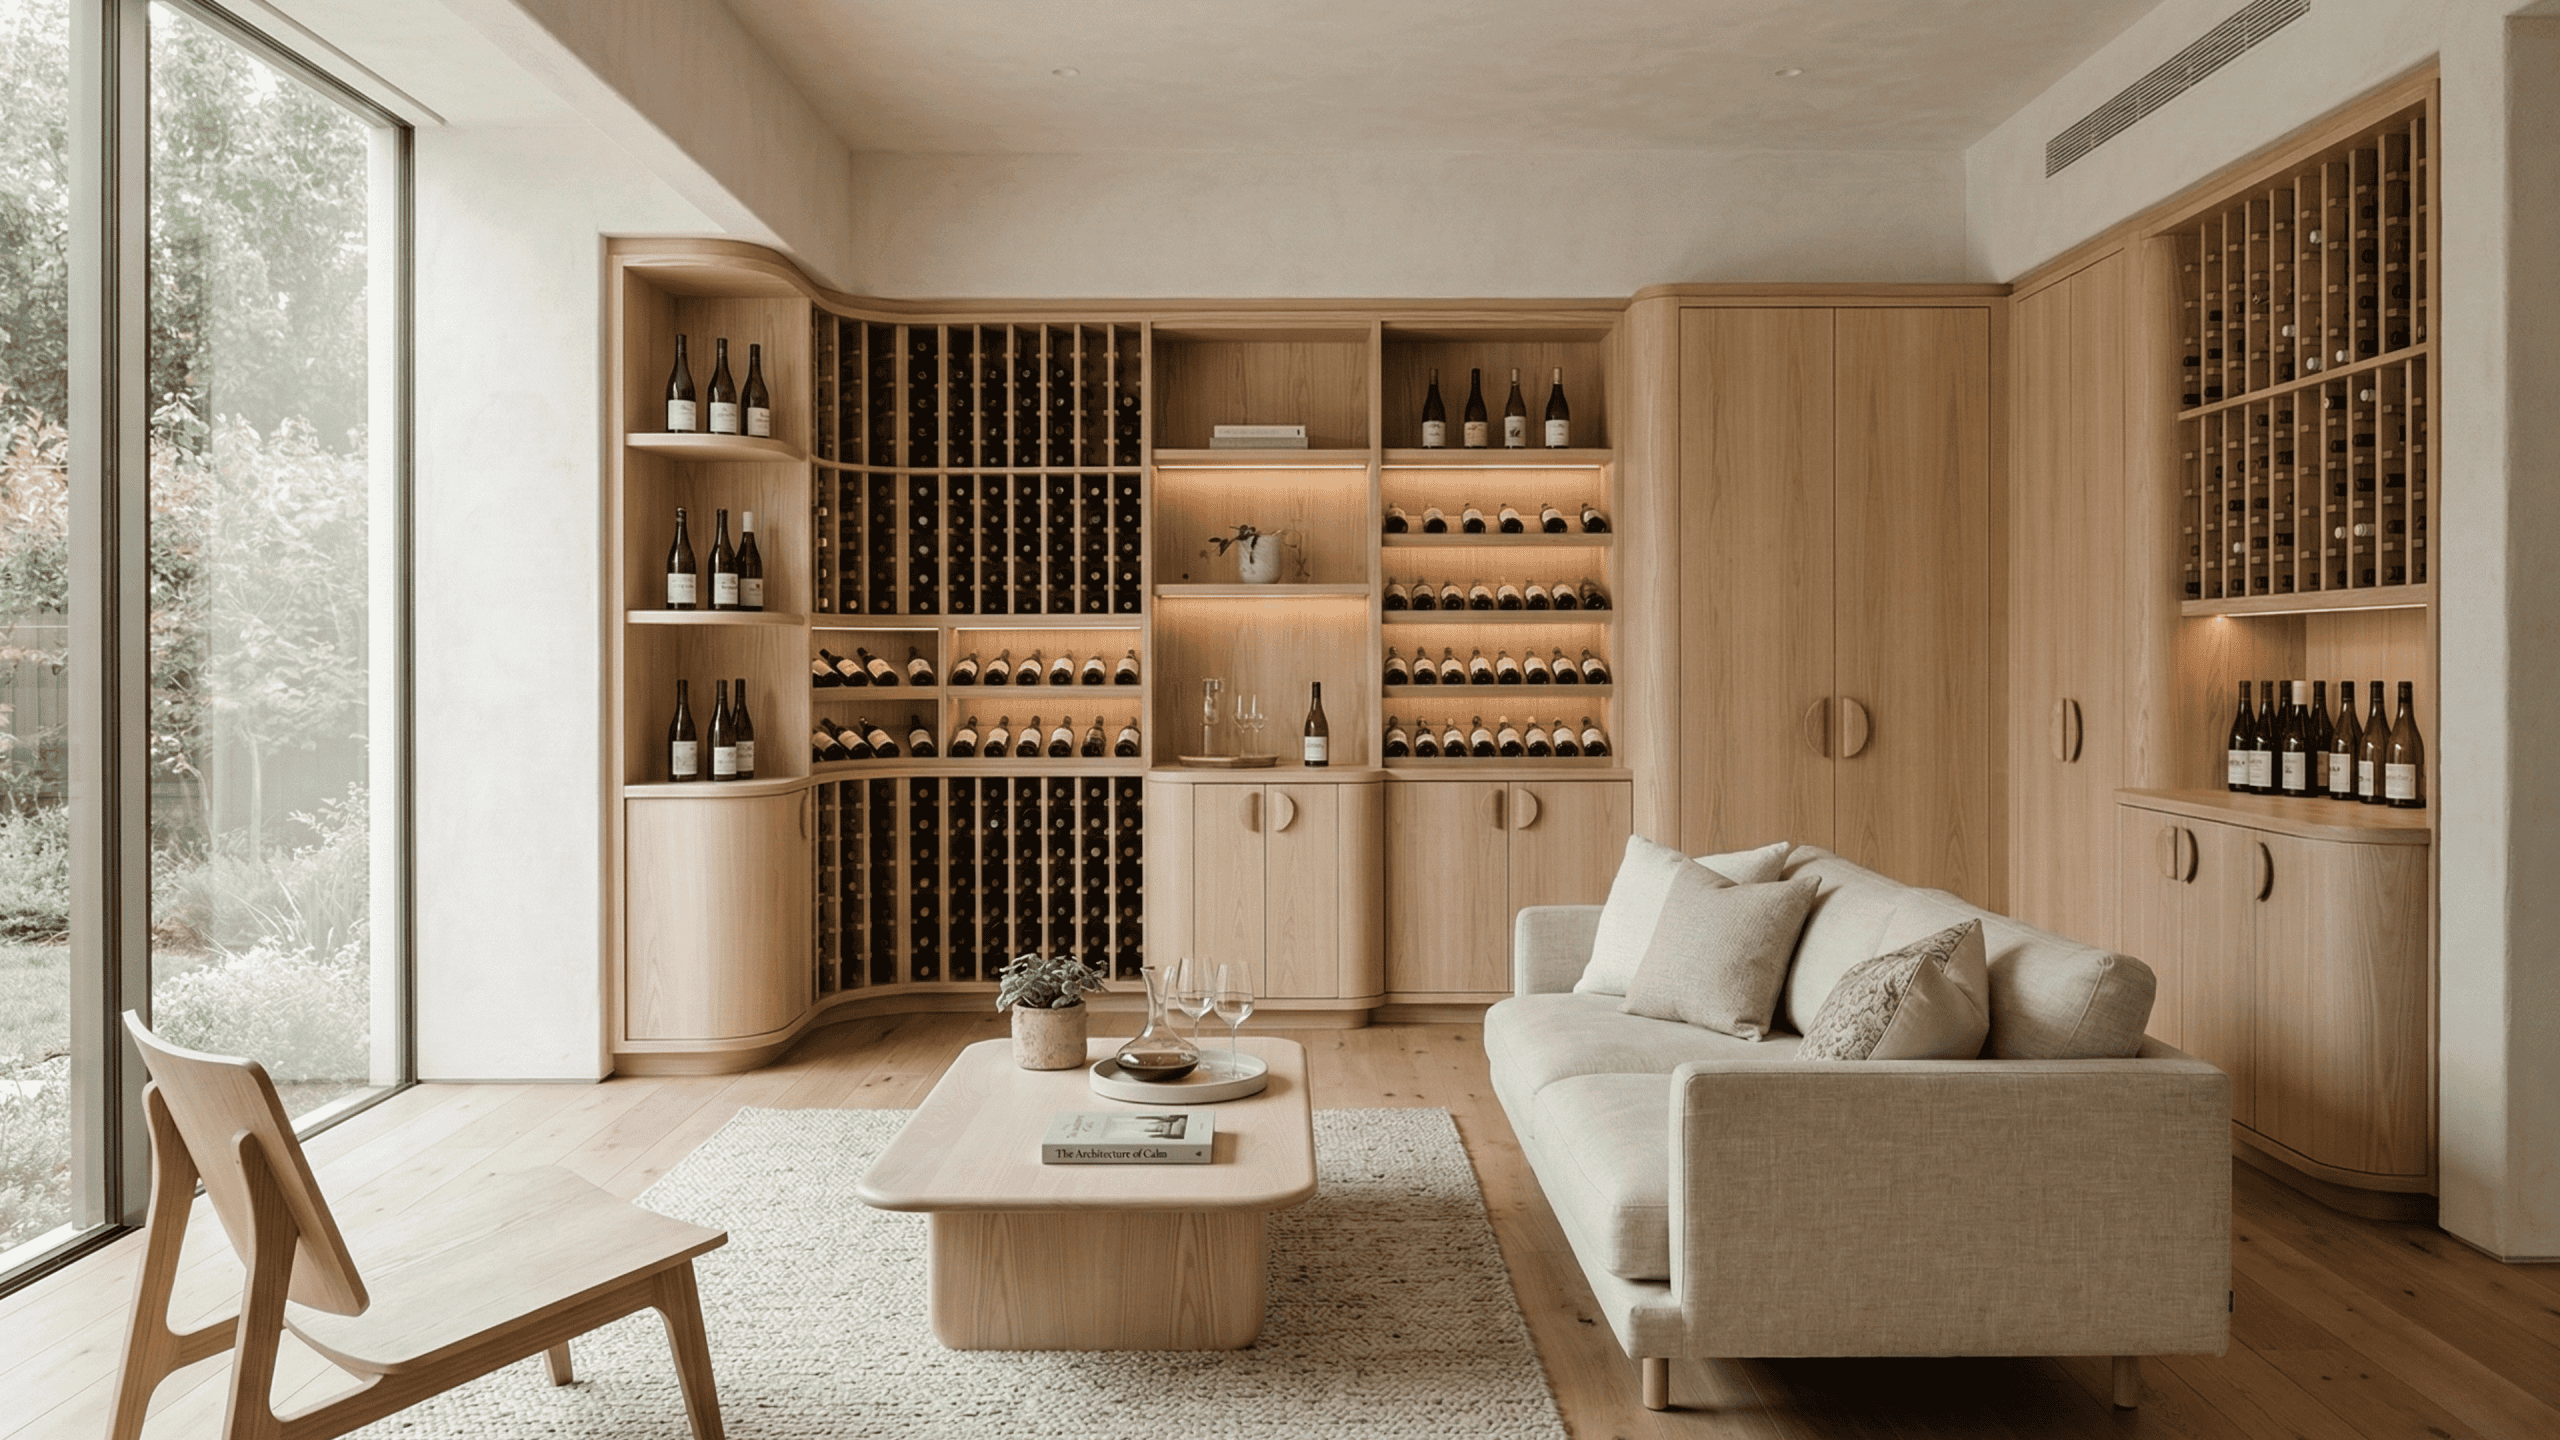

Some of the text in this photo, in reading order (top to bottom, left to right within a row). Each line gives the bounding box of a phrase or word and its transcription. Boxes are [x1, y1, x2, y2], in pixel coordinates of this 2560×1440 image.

[1056, 1149, 1074, 1159] The
[1075, 1149, 1131, 1159] Architecture
[1132, 1149, 1142, 1159] of
